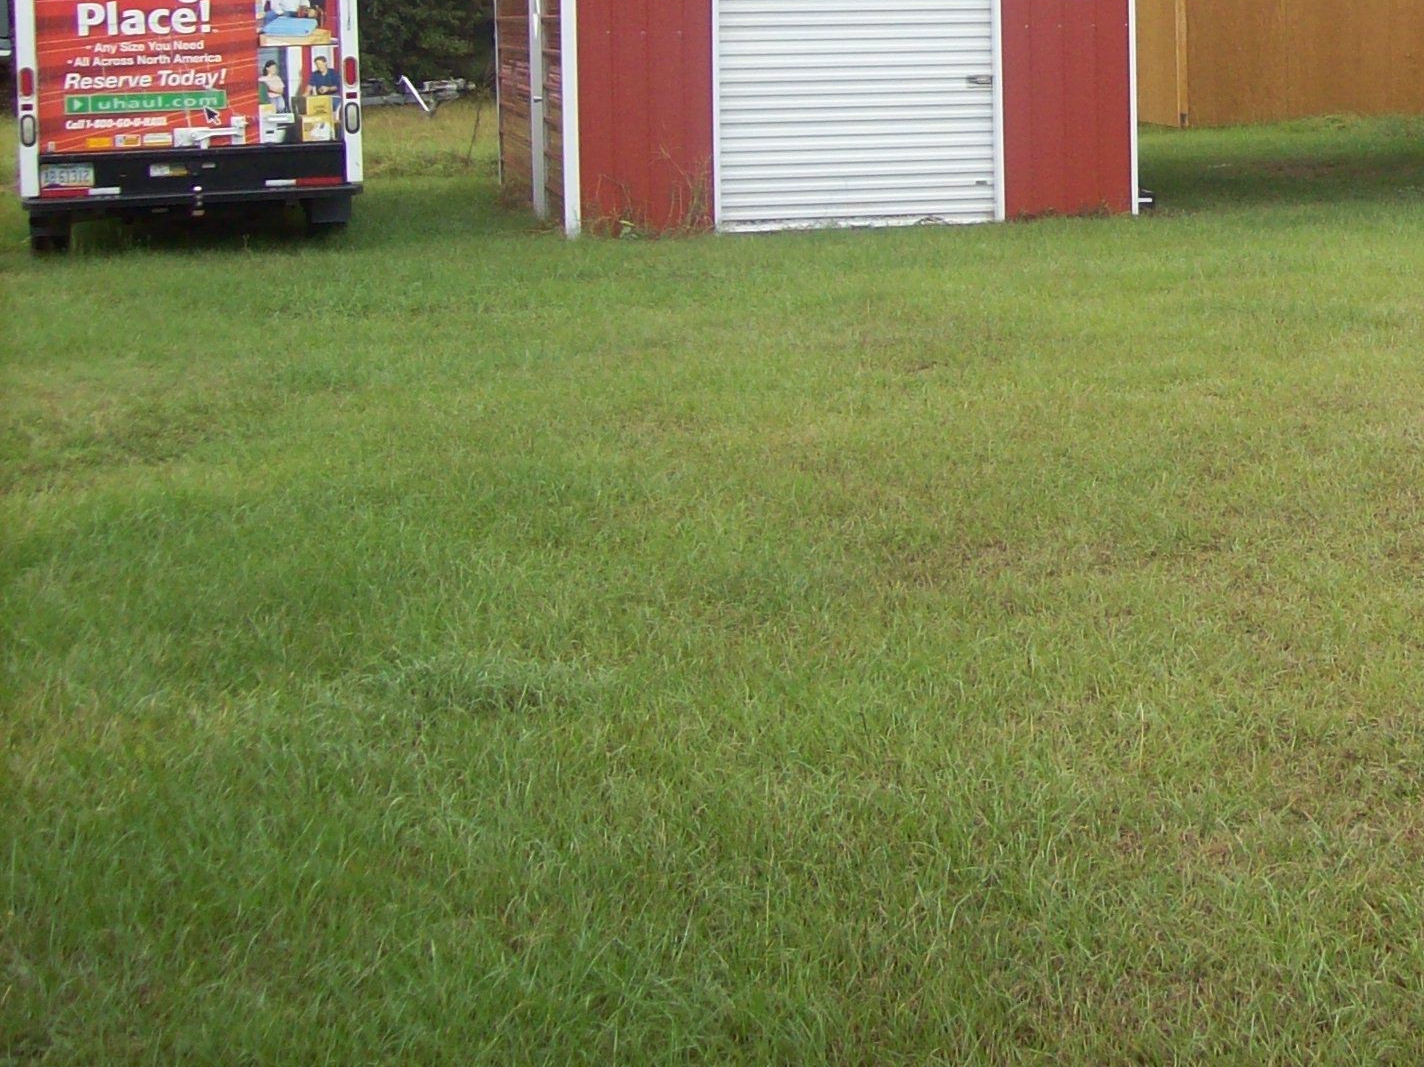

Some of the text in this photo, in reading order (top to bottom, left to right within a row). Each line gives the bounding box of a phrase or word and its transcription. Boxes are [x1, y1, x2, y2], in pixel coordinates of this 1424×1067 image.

[77, 0, 211, 37] Place!
[93, 40, 205, 54] Any Size You Need
[73, 53, 223, 67] All Across North America
[64, 68, 228, 90] Reserve Today!
[97, 96, 219, 109] uhaul.com
